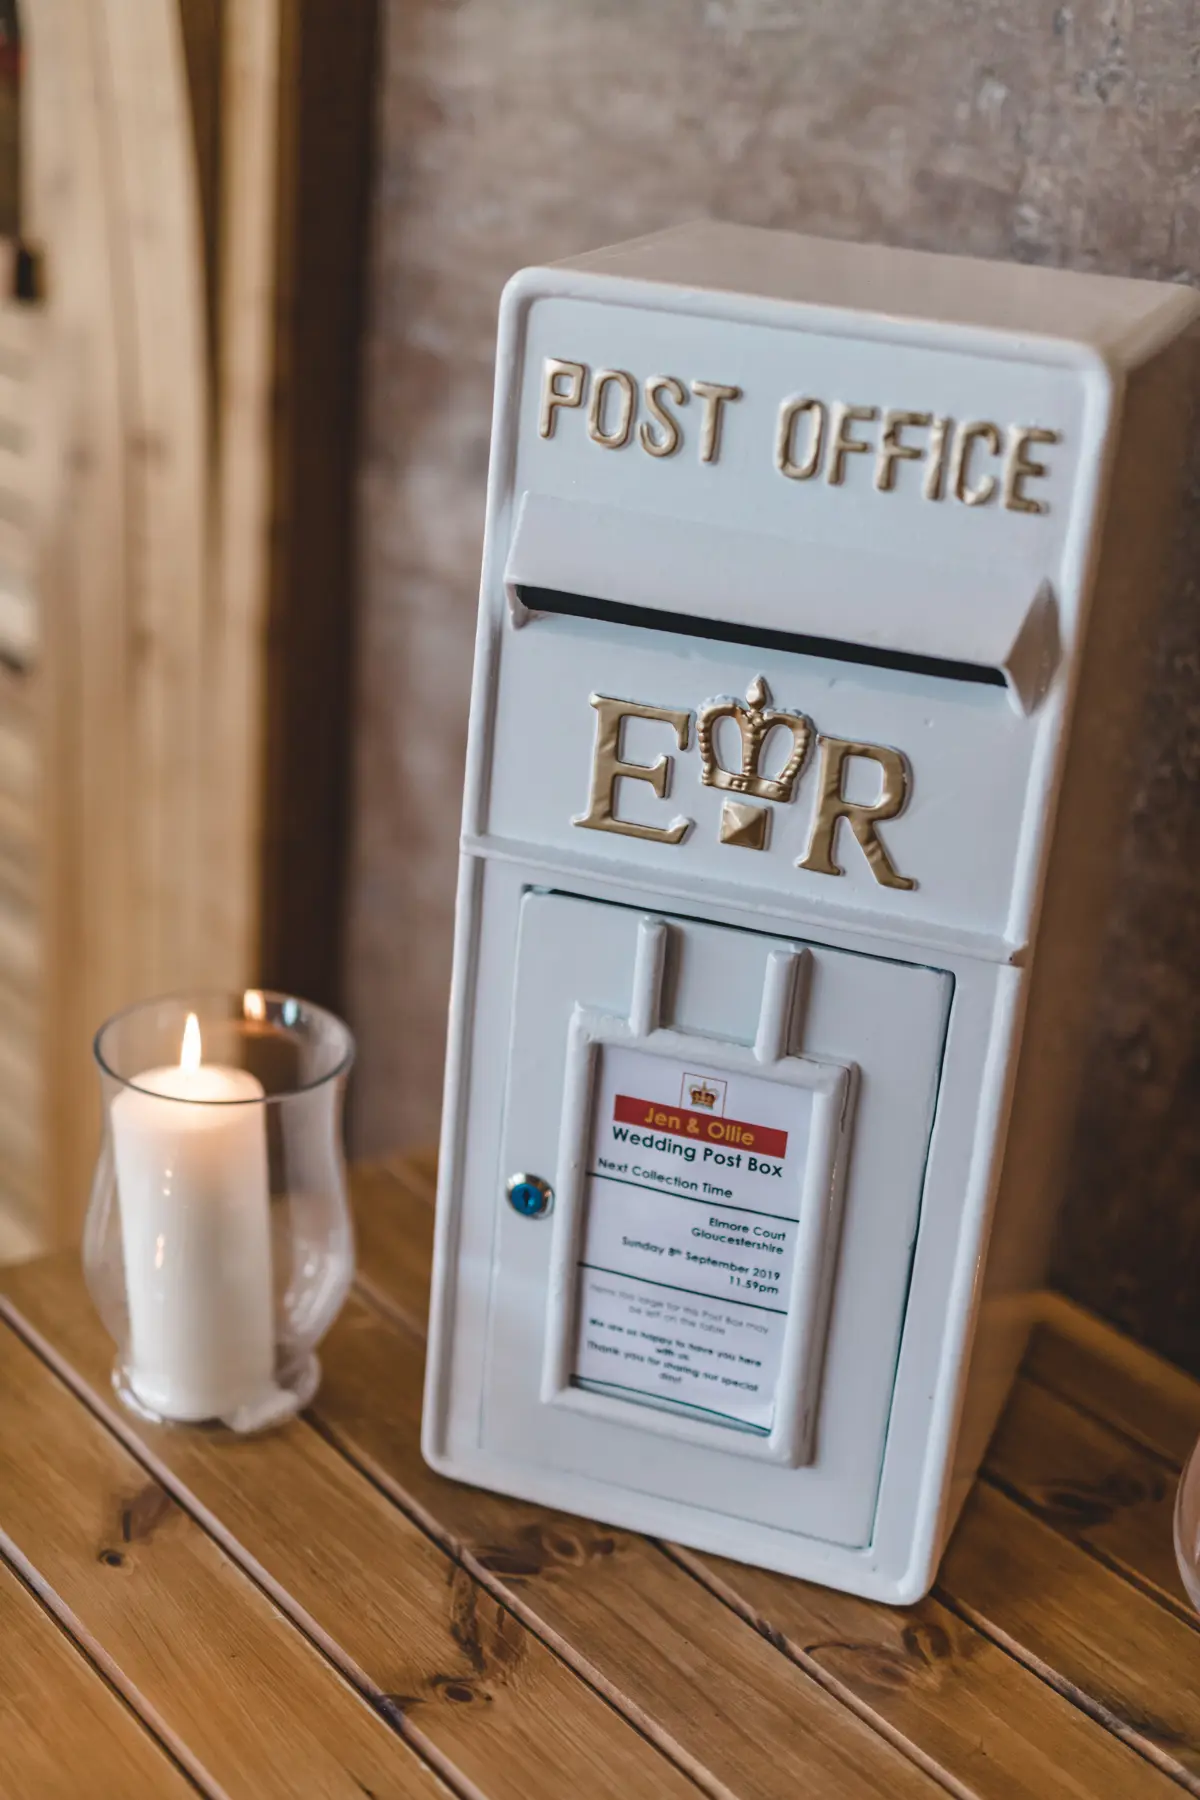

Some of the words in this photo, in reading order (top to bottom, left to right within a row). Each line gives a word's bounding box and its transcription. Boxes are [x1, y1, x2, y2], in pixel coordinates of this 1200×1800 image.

[539, 357, 742, 464] POST
[775, 392, 1060, 514] OFFICE
[644, 1107, 681, 1130] Jen
[686, 1118, 700, 1135] &
[707, 1121, 755, 1146] Ollie
[612, 1126, 696, 1162] Wedding
[703, 1148, 742, 1169] Post
[748, 1157, 784, 1178] Box
[598, 1158, 628, 1173] Next
[632, 1165, 698, 1191] Collection
[702, 1183, 733, 1199] Time
[691, 1227, 784, 1255] Gloucestershire
[709, 1217, 749, 1233] Elmore
[752, 1226, 786, 1241] Court
[622, 1236, 664, 1255] Sunday
[685, 1251, 749, 1274] September
[752, 1267, 780, 1281] 2019
[729, 1275, 779, 1295] 11.59pm
[680, 1316, 696, 1328] the
[702, 1310, 723, 1323] Post
[726, 1316, 743, 1328] Box
[746, 1322, 769, 1335] may
[624, 1351, 644, 1363] you
[647, 1357, 661, 1366] for
[663, 1361, 699, 1379] sharing
[721, 1375, 759, 1392] special
[688, 1342, 713, 1356] have
[717, 1351, 736, 1363] you
[738, 1354, 762, 1368] here
